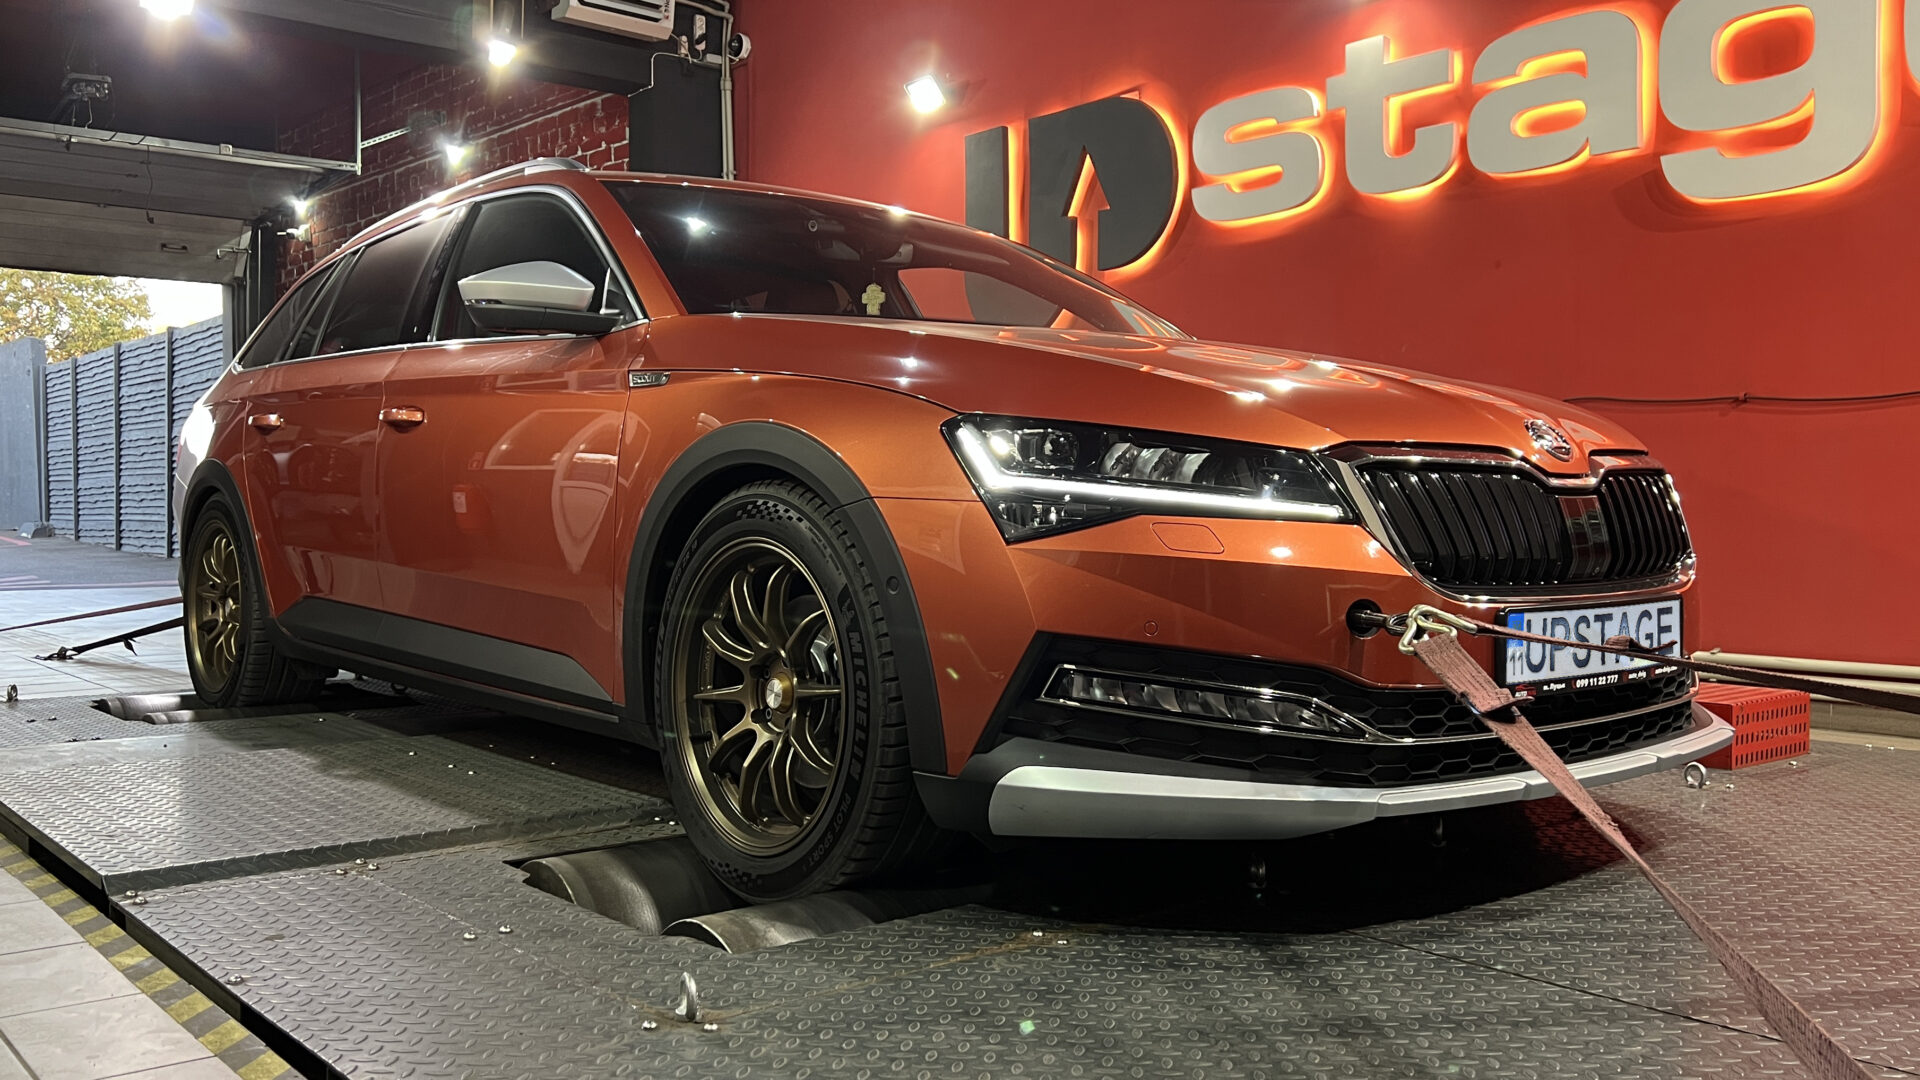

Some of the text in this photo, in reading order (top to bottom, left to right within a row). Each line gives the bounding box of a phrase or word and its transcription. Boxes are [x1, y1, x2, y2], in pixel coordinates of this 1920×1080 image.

[1525, 606, 1674, 673] UPSTAGE
[848, 631, 870, 782] MICHELIN
[1576, 674, 1618, 688] 099 11 22 777
[808, 792, 852, 867] PILOT SPORT
